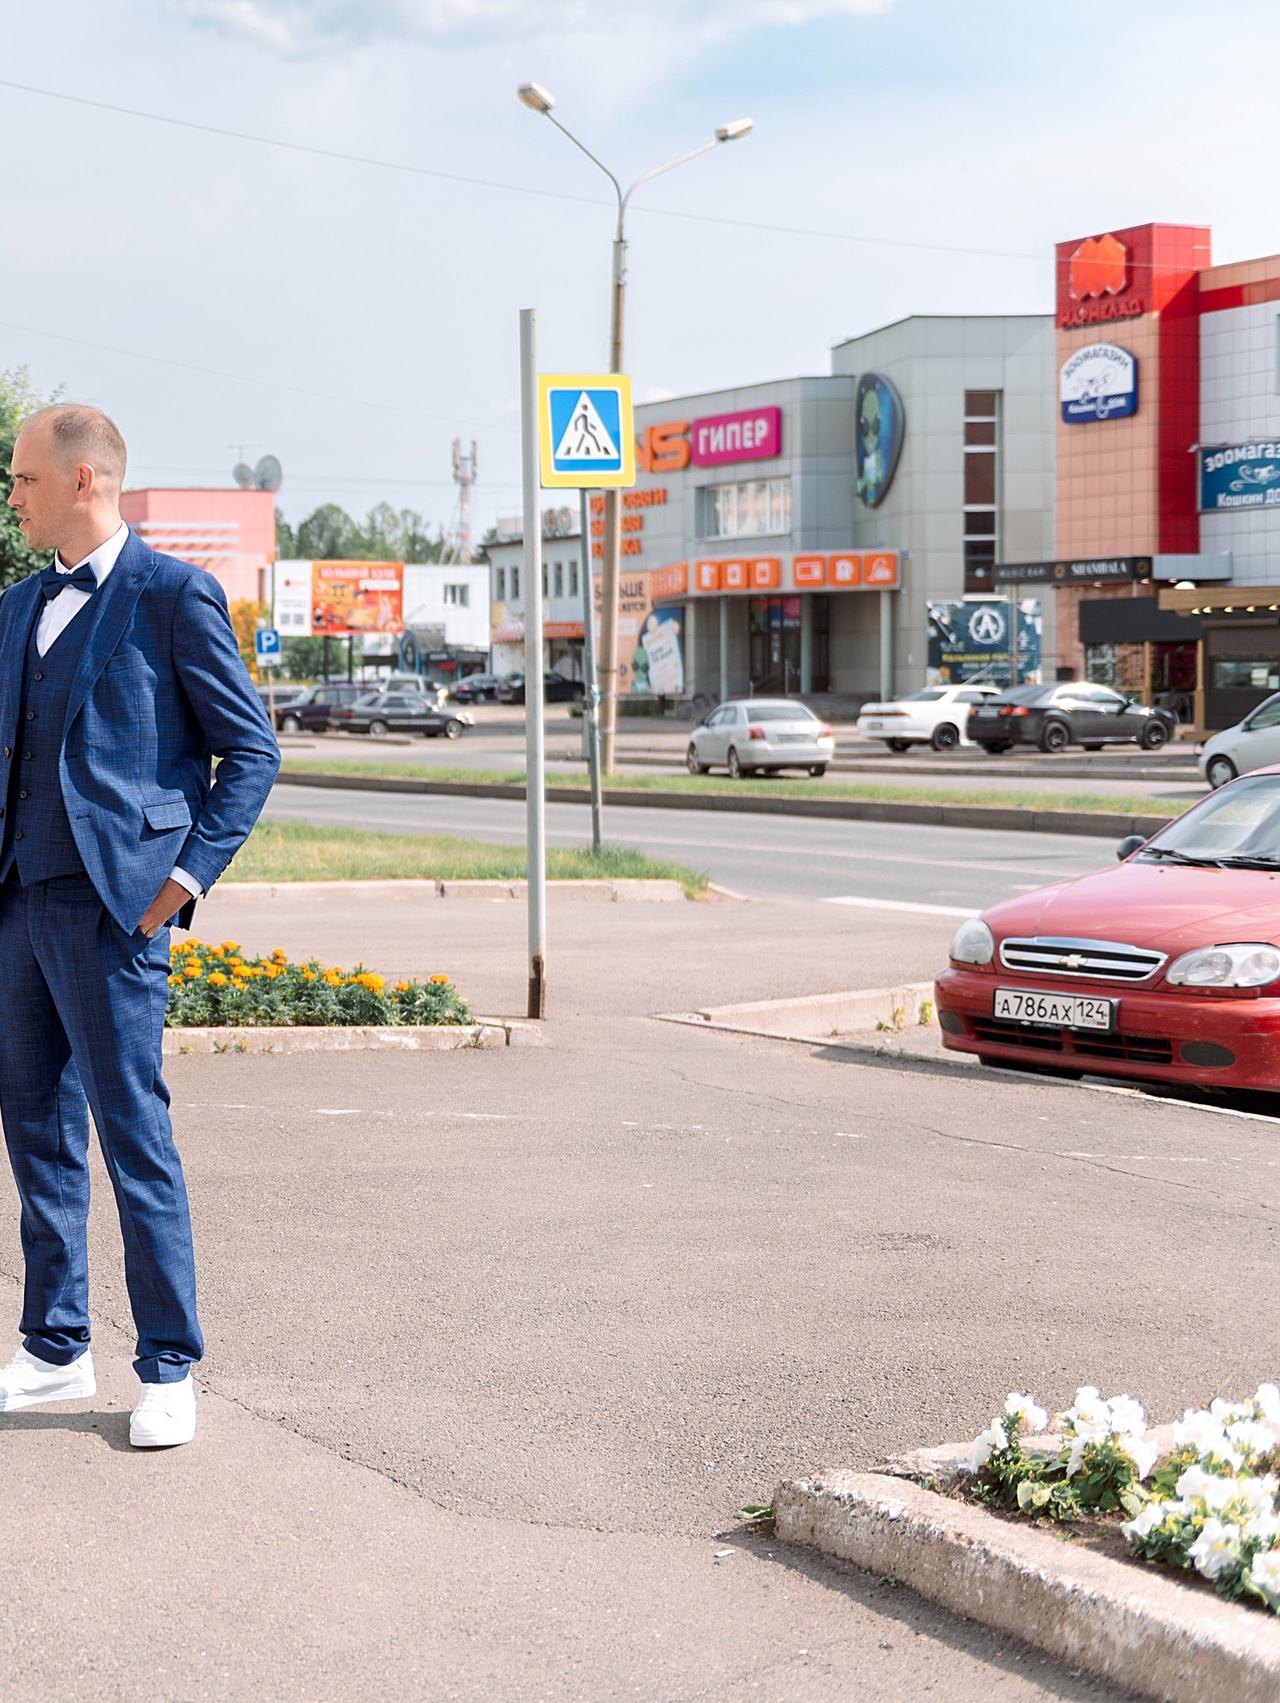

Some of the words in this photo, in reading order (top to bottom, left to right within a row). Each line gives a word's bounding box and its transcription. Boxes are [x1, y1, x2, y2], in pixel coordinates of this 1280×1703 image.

[1063, 346, 1128, 379] ЗООМАГАЗИН
[698, 418, 768, 456] ГИПЕР
[1217, 492, 1263, 507] Кошкин
[261, 631, 276, 651] P
[1076, 1001, 1106, 1020] 124
